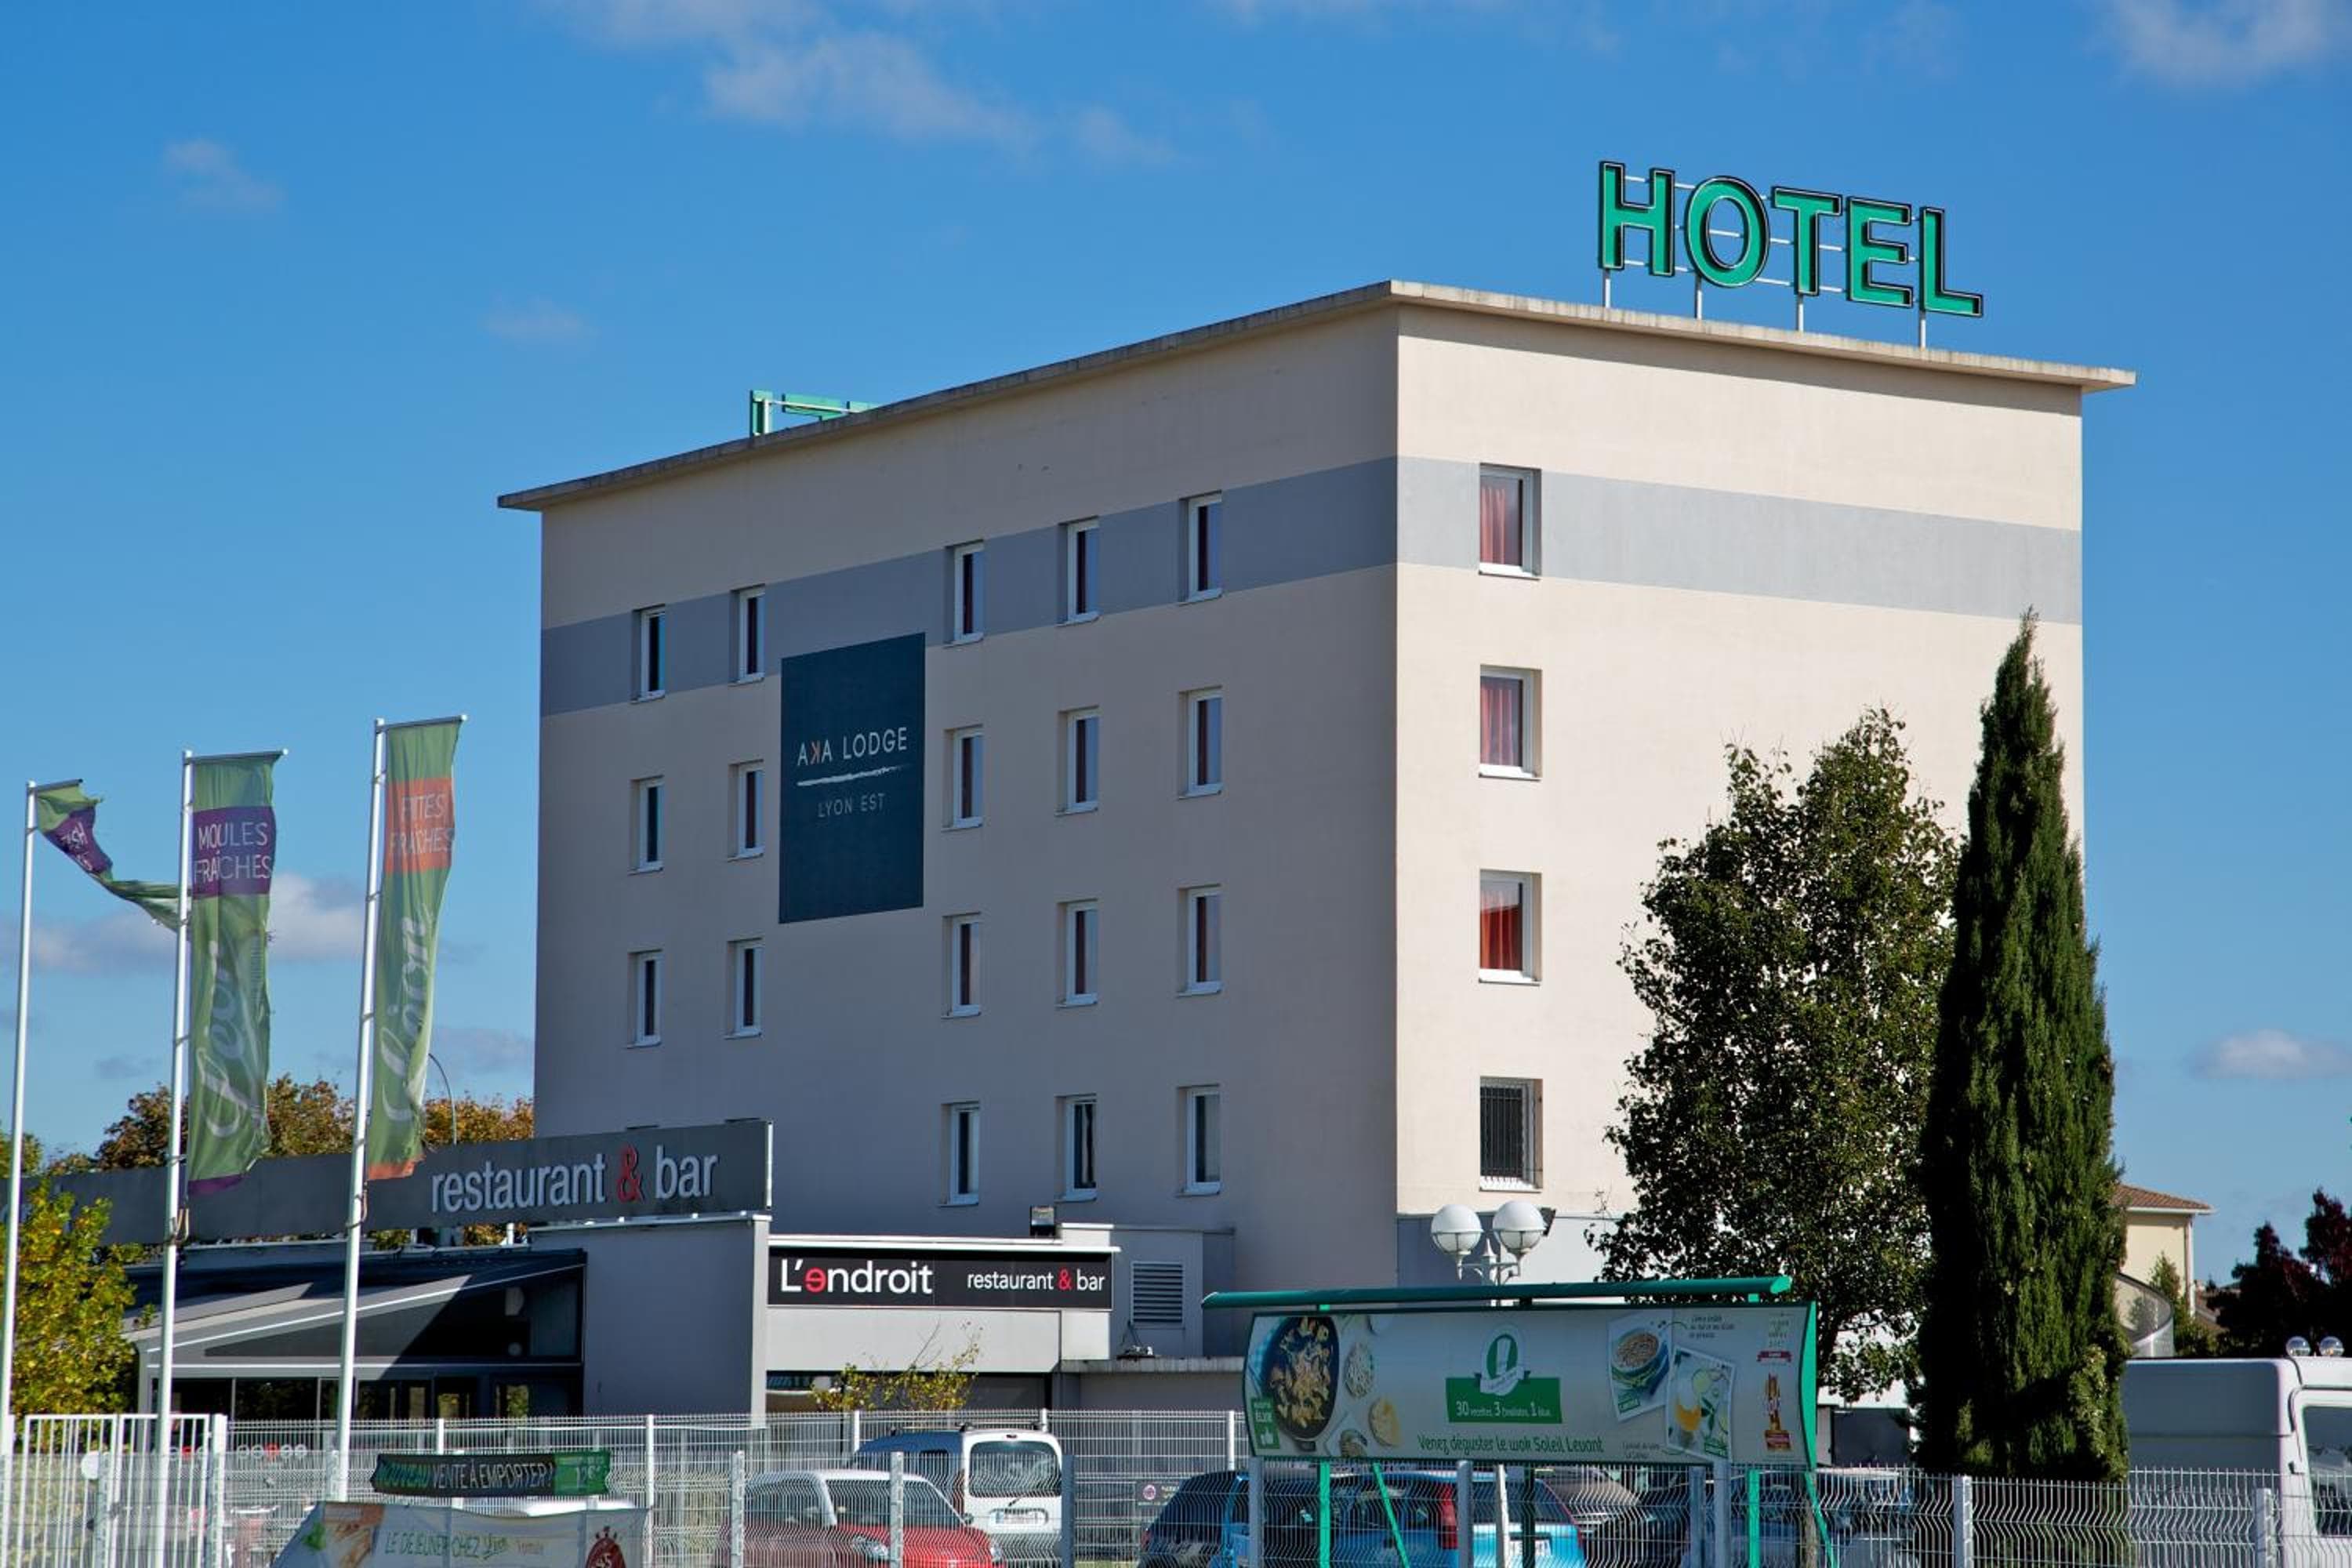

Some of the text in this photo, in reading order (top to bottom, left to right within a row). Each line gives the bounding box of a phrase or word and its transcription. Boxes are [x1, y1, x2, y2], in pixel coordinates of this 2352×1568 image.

[1599, 161, 1983, 317] HOTEL
[843, 726, 907, 760] LODGE
[818, 793, 885, 818] LYON EST
[198, 821, 268, 851] MOULES
[431, 1143, 718, 1214] restaurant & bar
[780, 1259, 1105, 1296] L'endroit restaurant & bar
[1417, 1435, 1447, 1454] Venez
[1495, 1435, 1508, 1452] le
[1534, 1435, 1564, 1454] Soleil
[1566, 1435, 1605, 1454] Levant
[432, 1463, 468, 1490] VENTE
